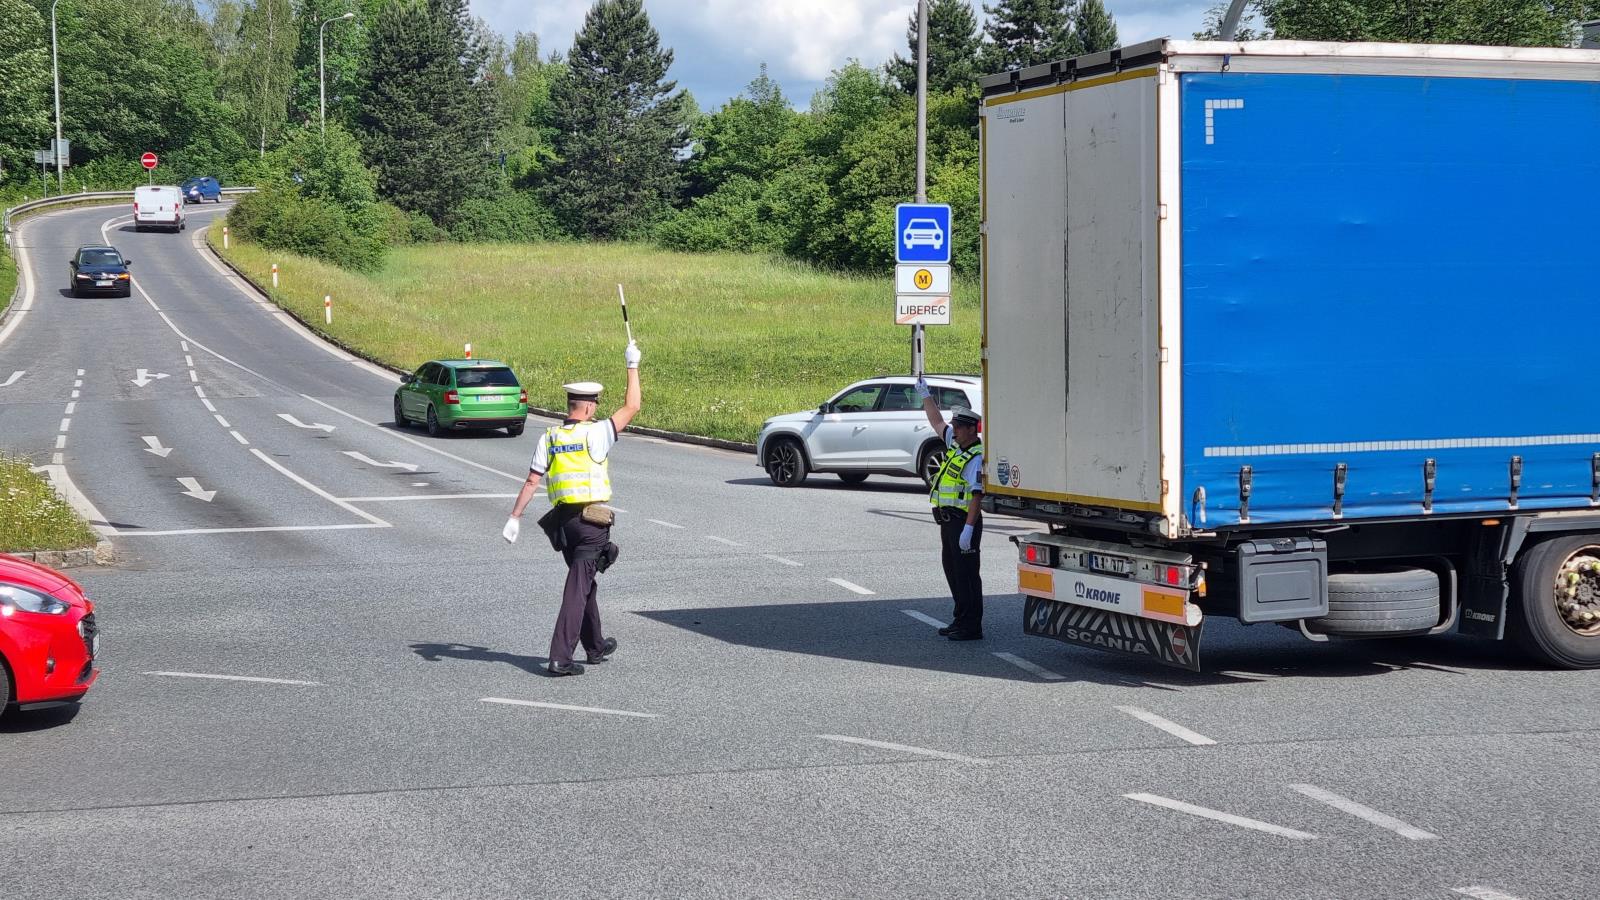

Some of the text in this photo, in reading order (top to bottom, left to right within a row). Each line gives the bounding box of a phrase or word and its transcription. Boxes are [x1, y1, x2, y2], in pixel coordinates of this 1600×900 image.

[918, 275, 928, 284] M
[900, 305, 946, 316] LIBEREC
[549, 444, 583, 454] POLICIE
[1086, 587, 1121, 605] KRONE
[1472, 612, 1496, 623] KRONE
[1066, 628, 1151, 655] SCANIA
